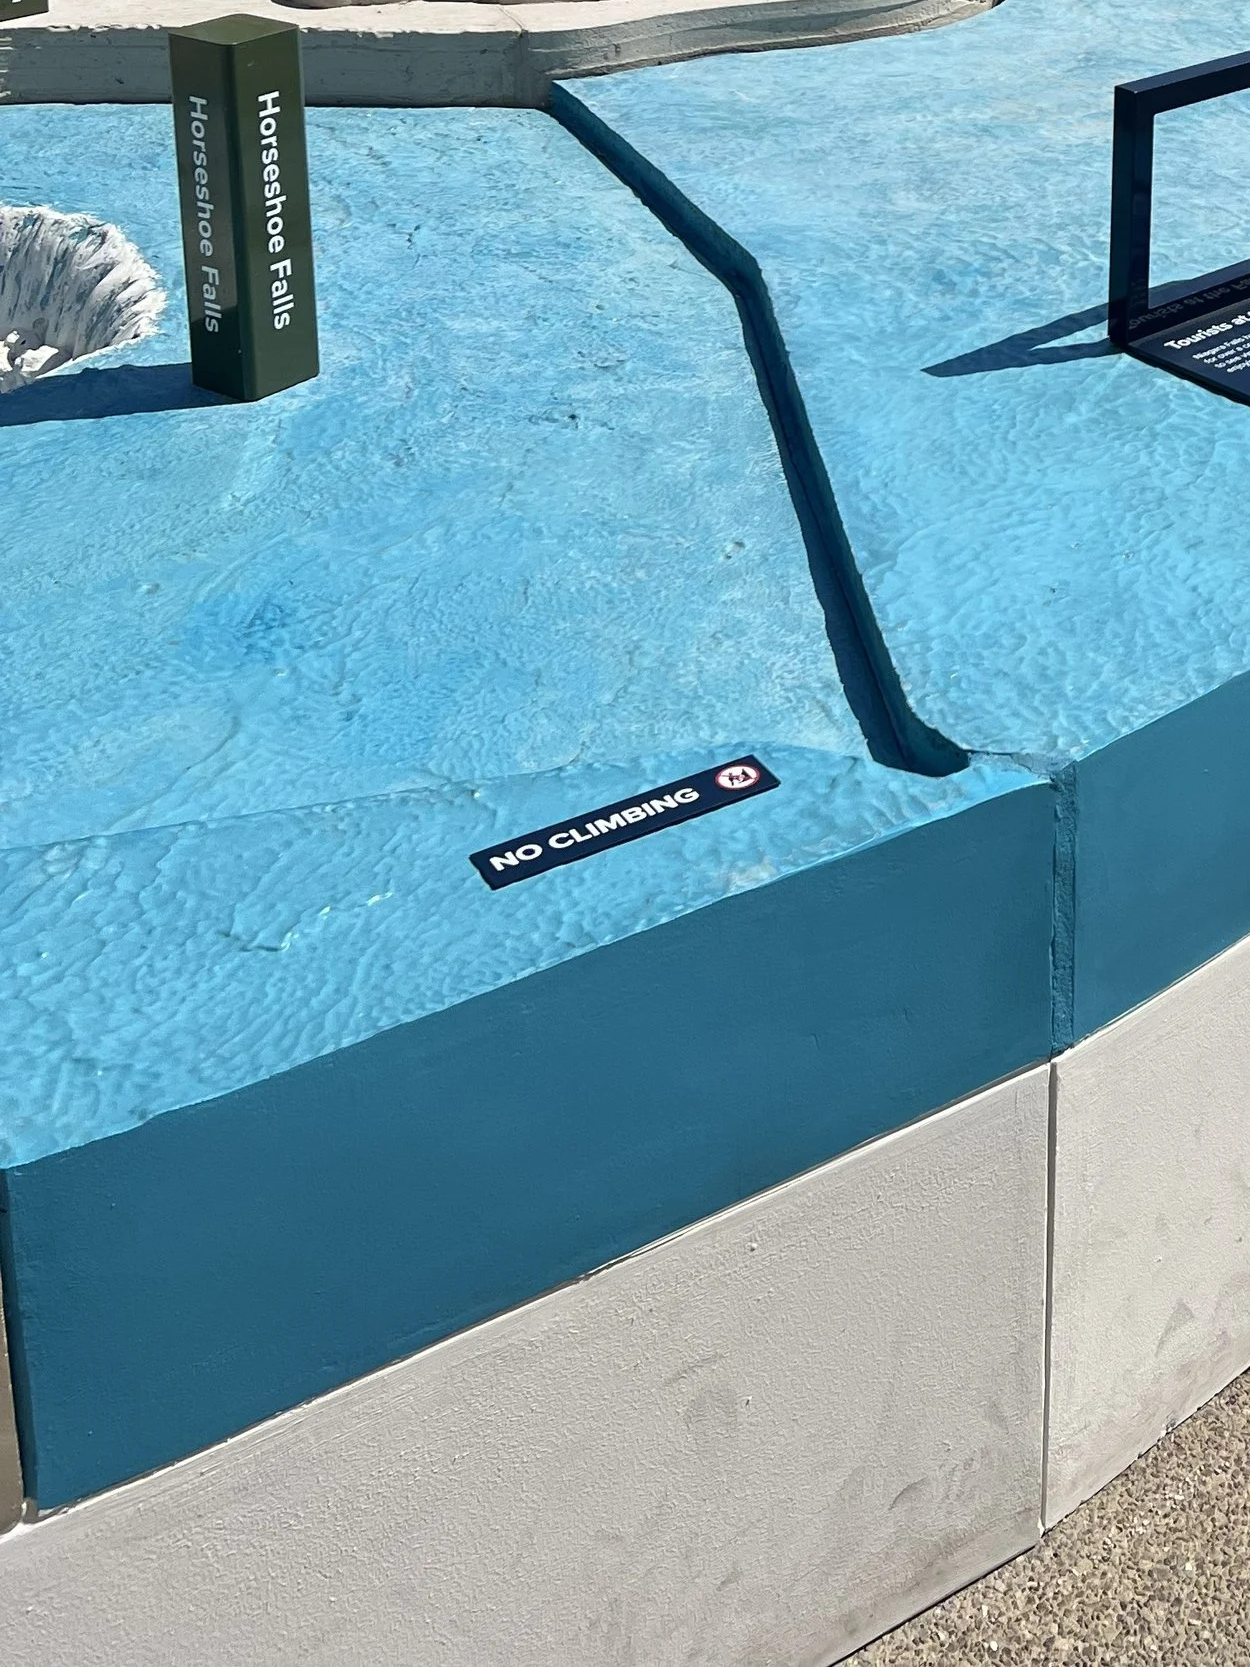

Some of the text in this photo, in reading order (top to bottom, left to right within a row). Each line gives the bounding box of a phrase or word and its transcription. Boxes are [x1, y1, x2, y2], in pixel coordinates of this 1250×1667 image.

[189, 95, 222, 333] Horseshoe Falls
[257, 91, 295, 330] Horseshoe Falls
[1163, 322, 1233, 349] Tourists
[1192, 345, 1226, 359] Niagara
[1223, 337, 1245, 346] Falls
[1217, 348, 1236, 358] over
[1224, 355, 1241, 364] see
[489, 787, 700, 871] NO CLIMBING
